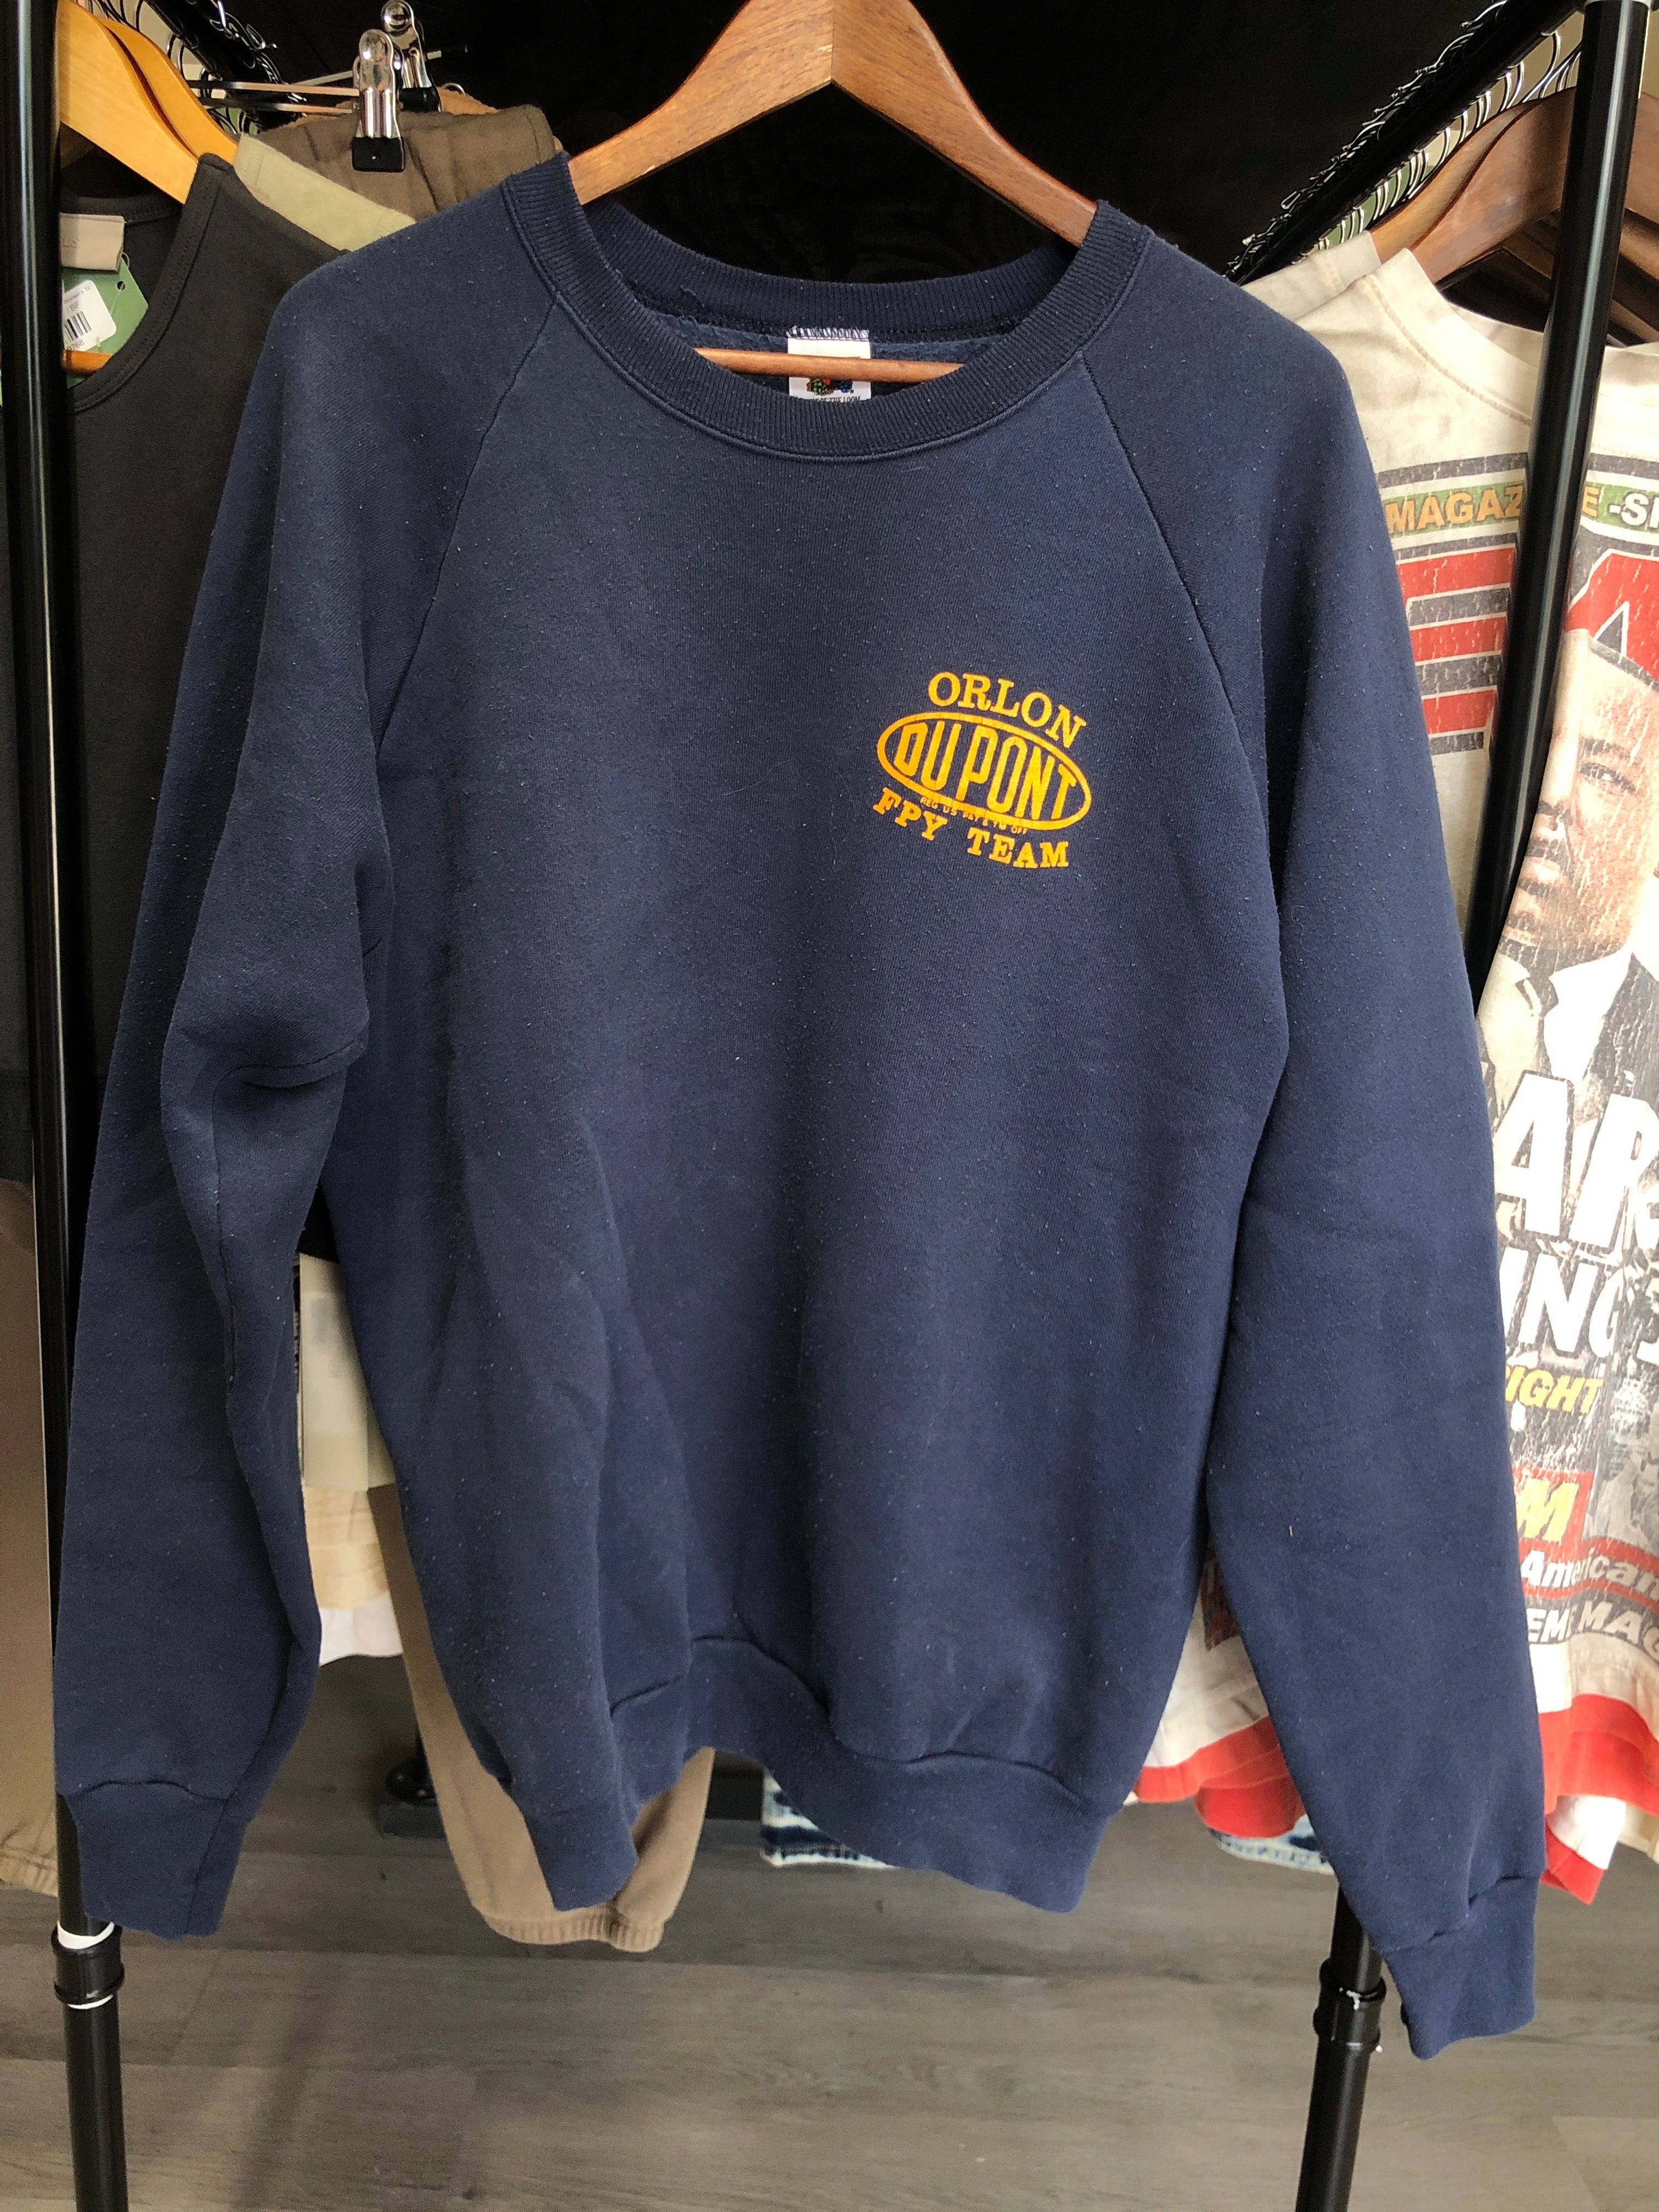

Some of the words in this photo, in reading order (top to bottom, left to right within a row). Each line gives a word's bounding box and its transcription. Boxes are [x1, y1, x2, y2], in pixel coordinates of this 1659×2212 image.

[928, 671, 1087, 748] ORLON
[894, 720, 962, 791] DU
[956, 724, 1077, 821] PONT
[873, 787, 948, 840] FPY
[967, 827, 1069, 868] TEAM
[920, 797, 938, 809] REG
[1011, 824, 1029, 835] OFF
[1505, 1364, 1604, 1413] IGHT
